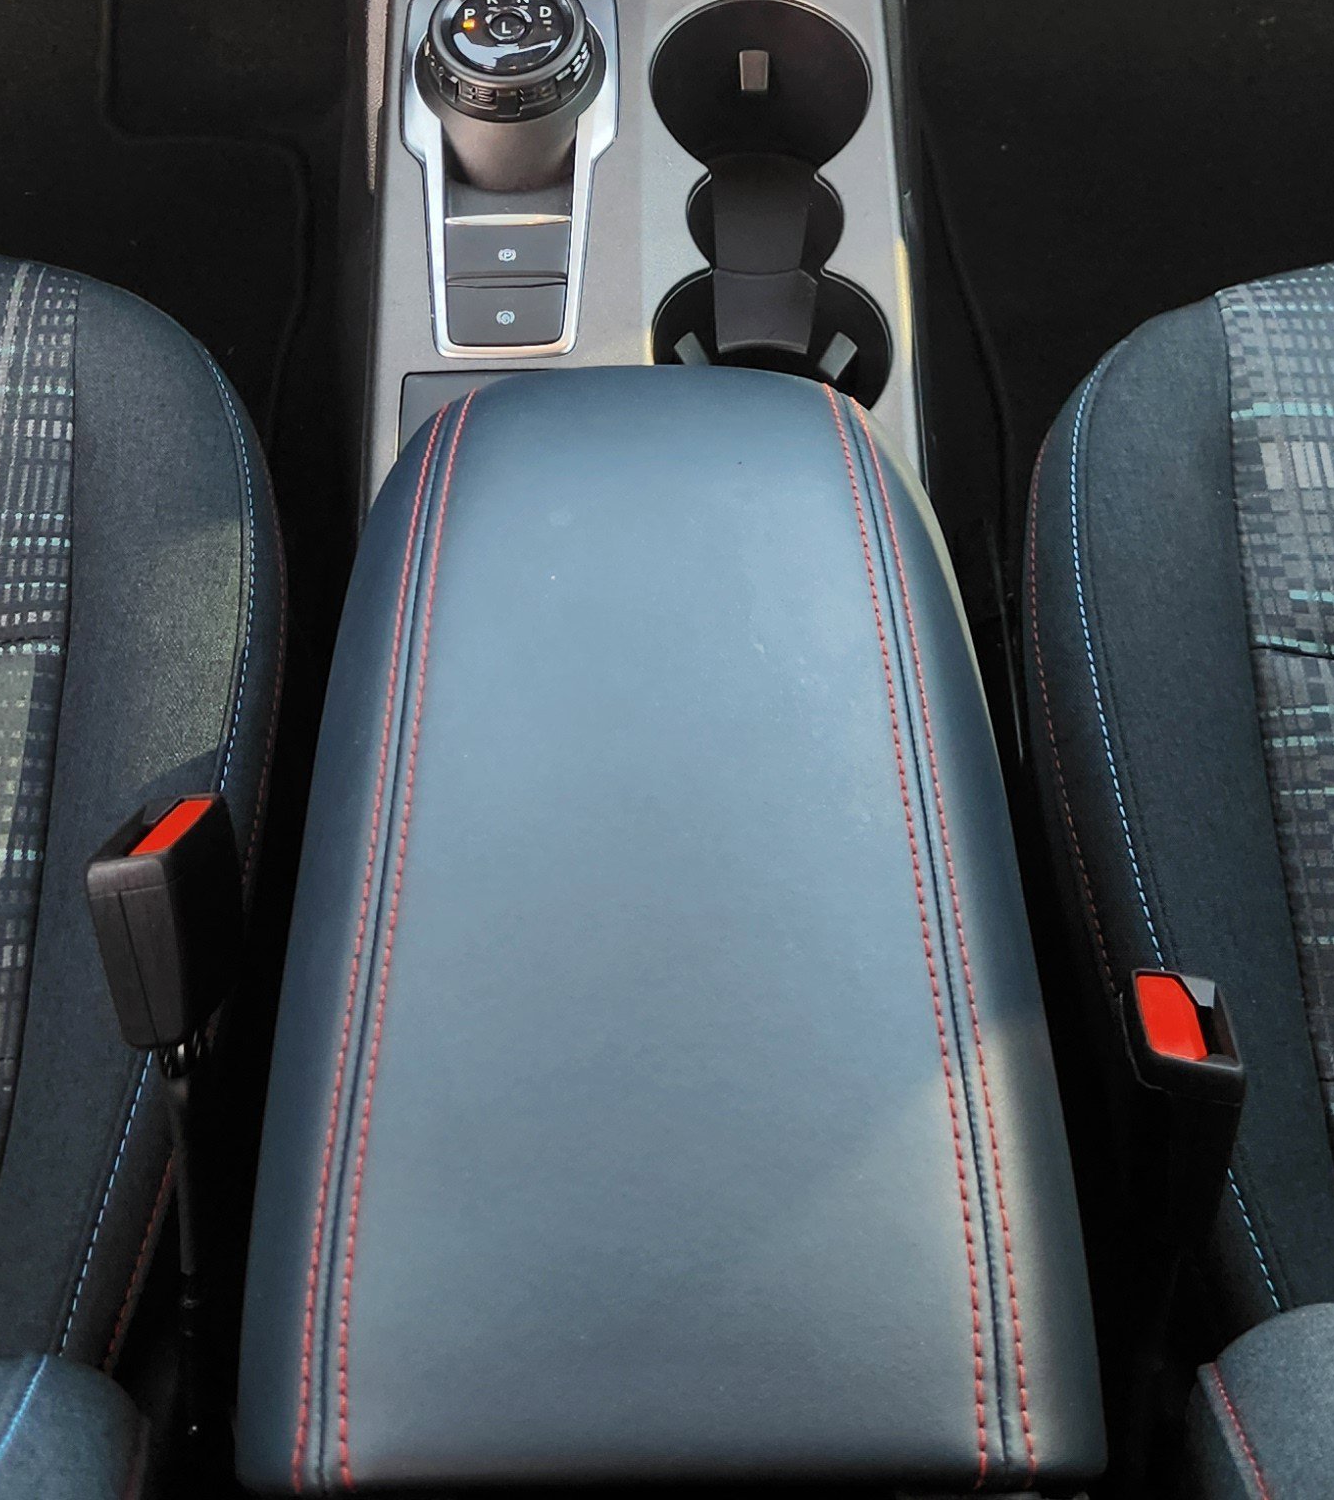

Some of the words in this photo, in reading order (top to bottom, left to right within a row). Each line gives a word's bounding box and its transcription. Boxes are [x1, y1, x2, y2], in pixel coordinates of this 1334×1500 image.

[464, 9, 476, 20] P
[539, 5, 552, 18] D
[502, 22, 512, 34] L
